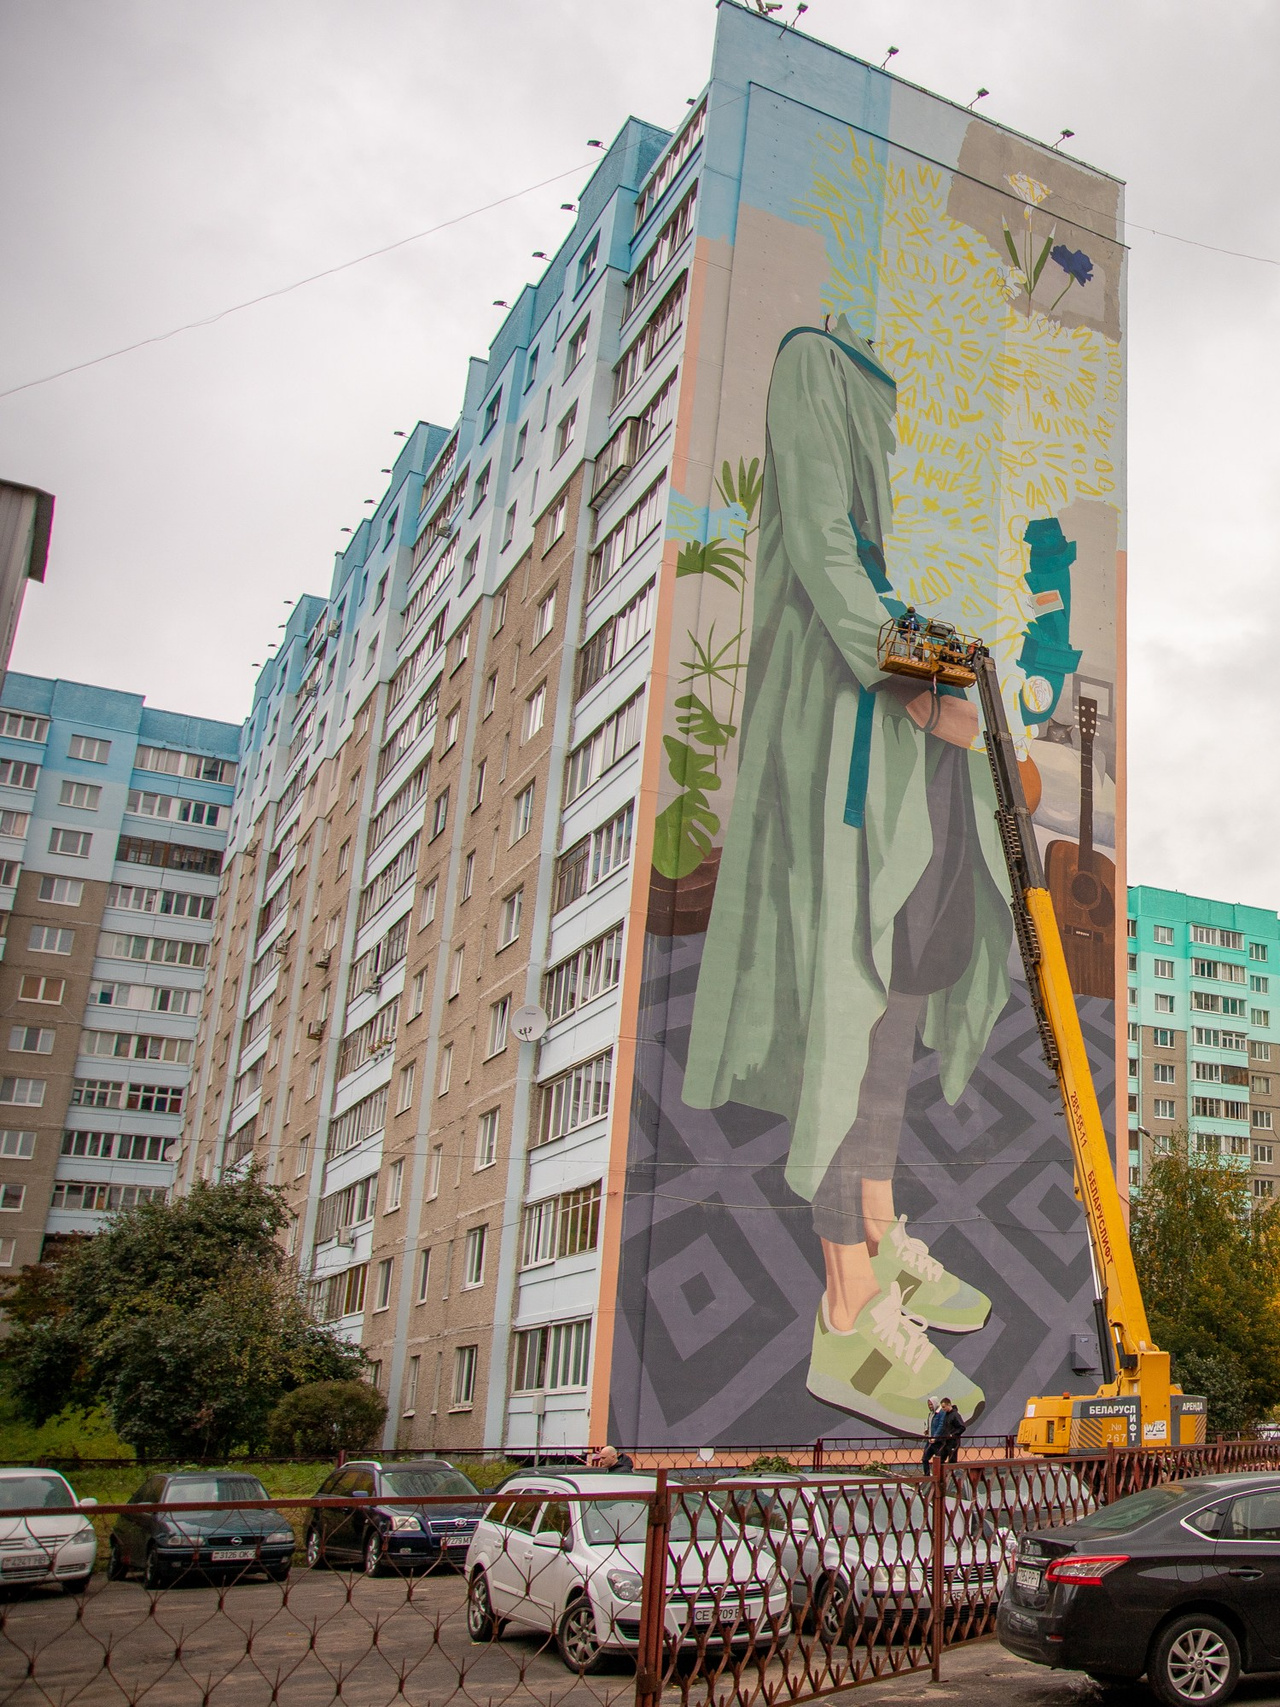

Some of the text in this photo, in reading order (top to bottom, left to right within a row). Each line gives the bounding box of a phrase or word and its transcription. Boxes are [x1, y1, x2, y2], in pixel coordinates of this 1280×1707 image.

[1087, 1169, 1114, 1265] БЕЛАРУСЛИФТ
[1181, 1402, 1204, 1412] АРЕНДА
[1106, 1433, 1127, 1443] 267
[220, 1551, 238, 1559] 3126
[695, 1610, 710, 1621] CE
